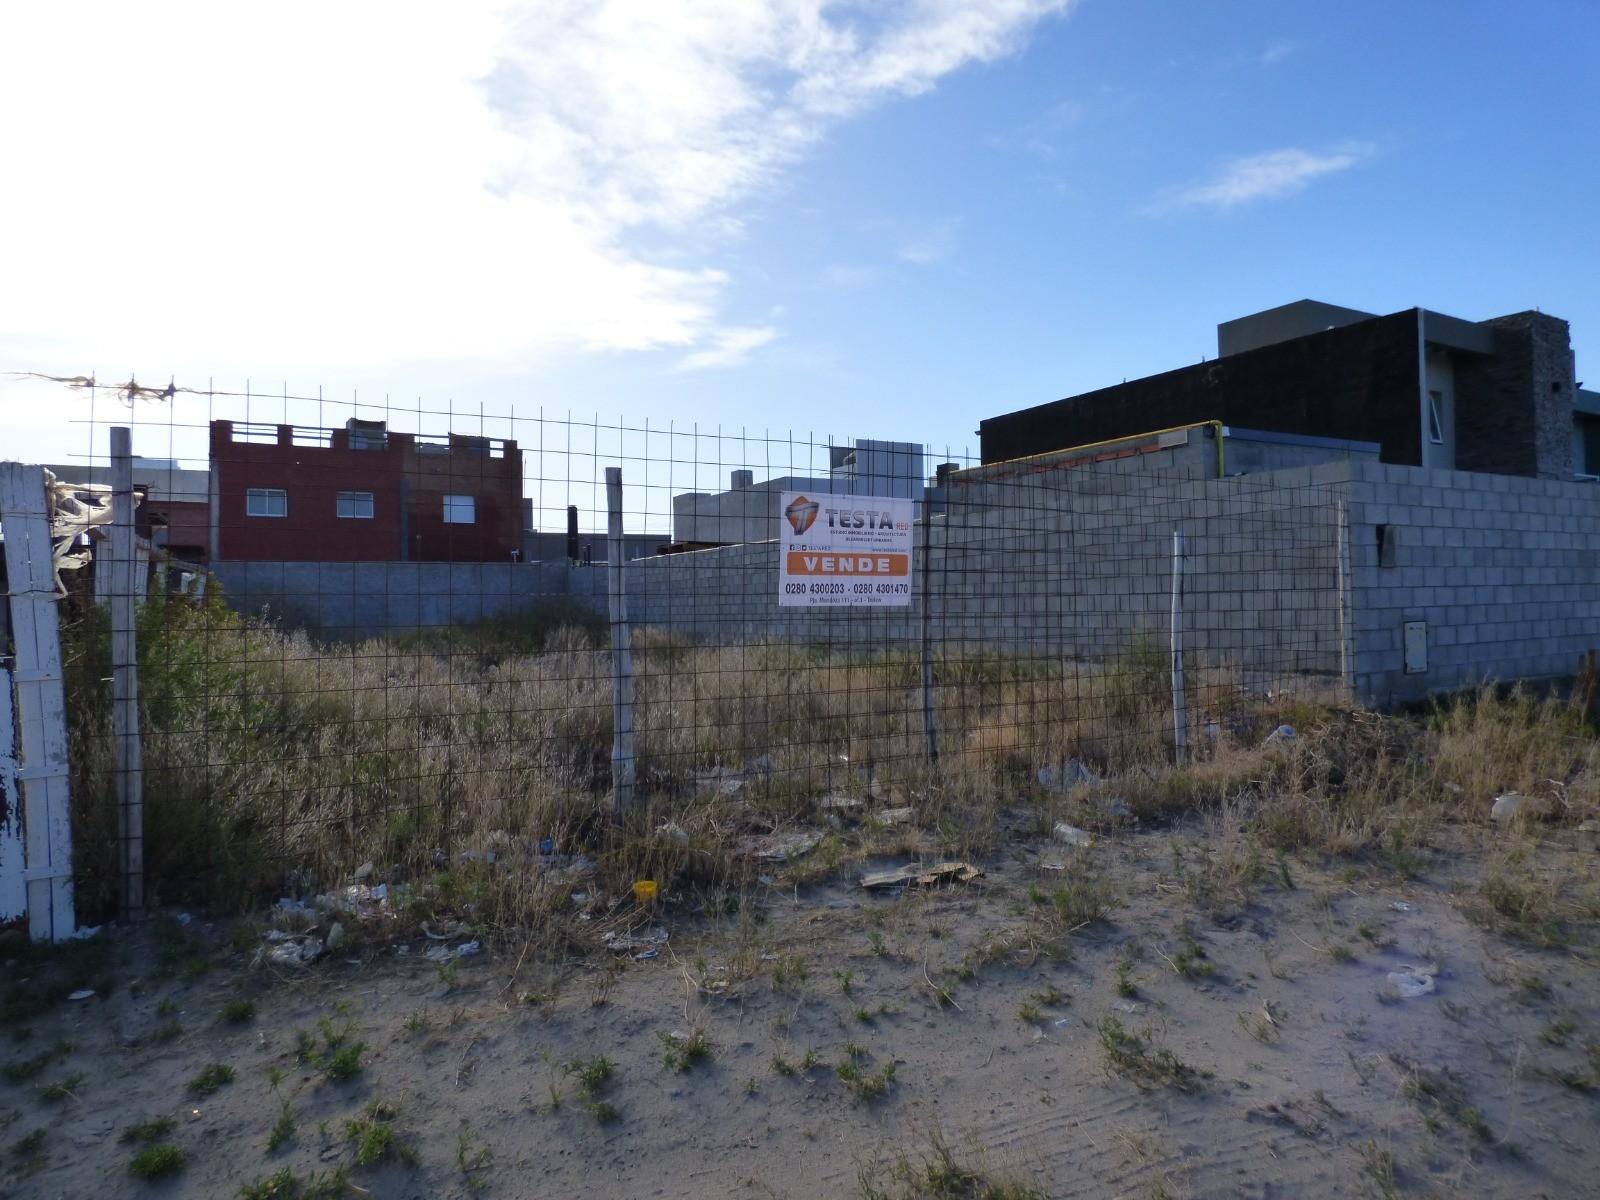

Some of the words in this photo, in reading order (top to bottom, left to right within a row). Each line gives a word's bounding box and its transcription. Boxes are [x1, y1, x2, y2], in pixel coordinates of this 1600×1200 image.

[825, 509, 893, 529] TESTA
[804, 556, 890, 573] VENDE
[785, 583, 807, 594] 0280
[810, 583, 845, 595] 4300203
[853, 584, 873, 594] 0280
[876, 584, 909, 594] 4301470
